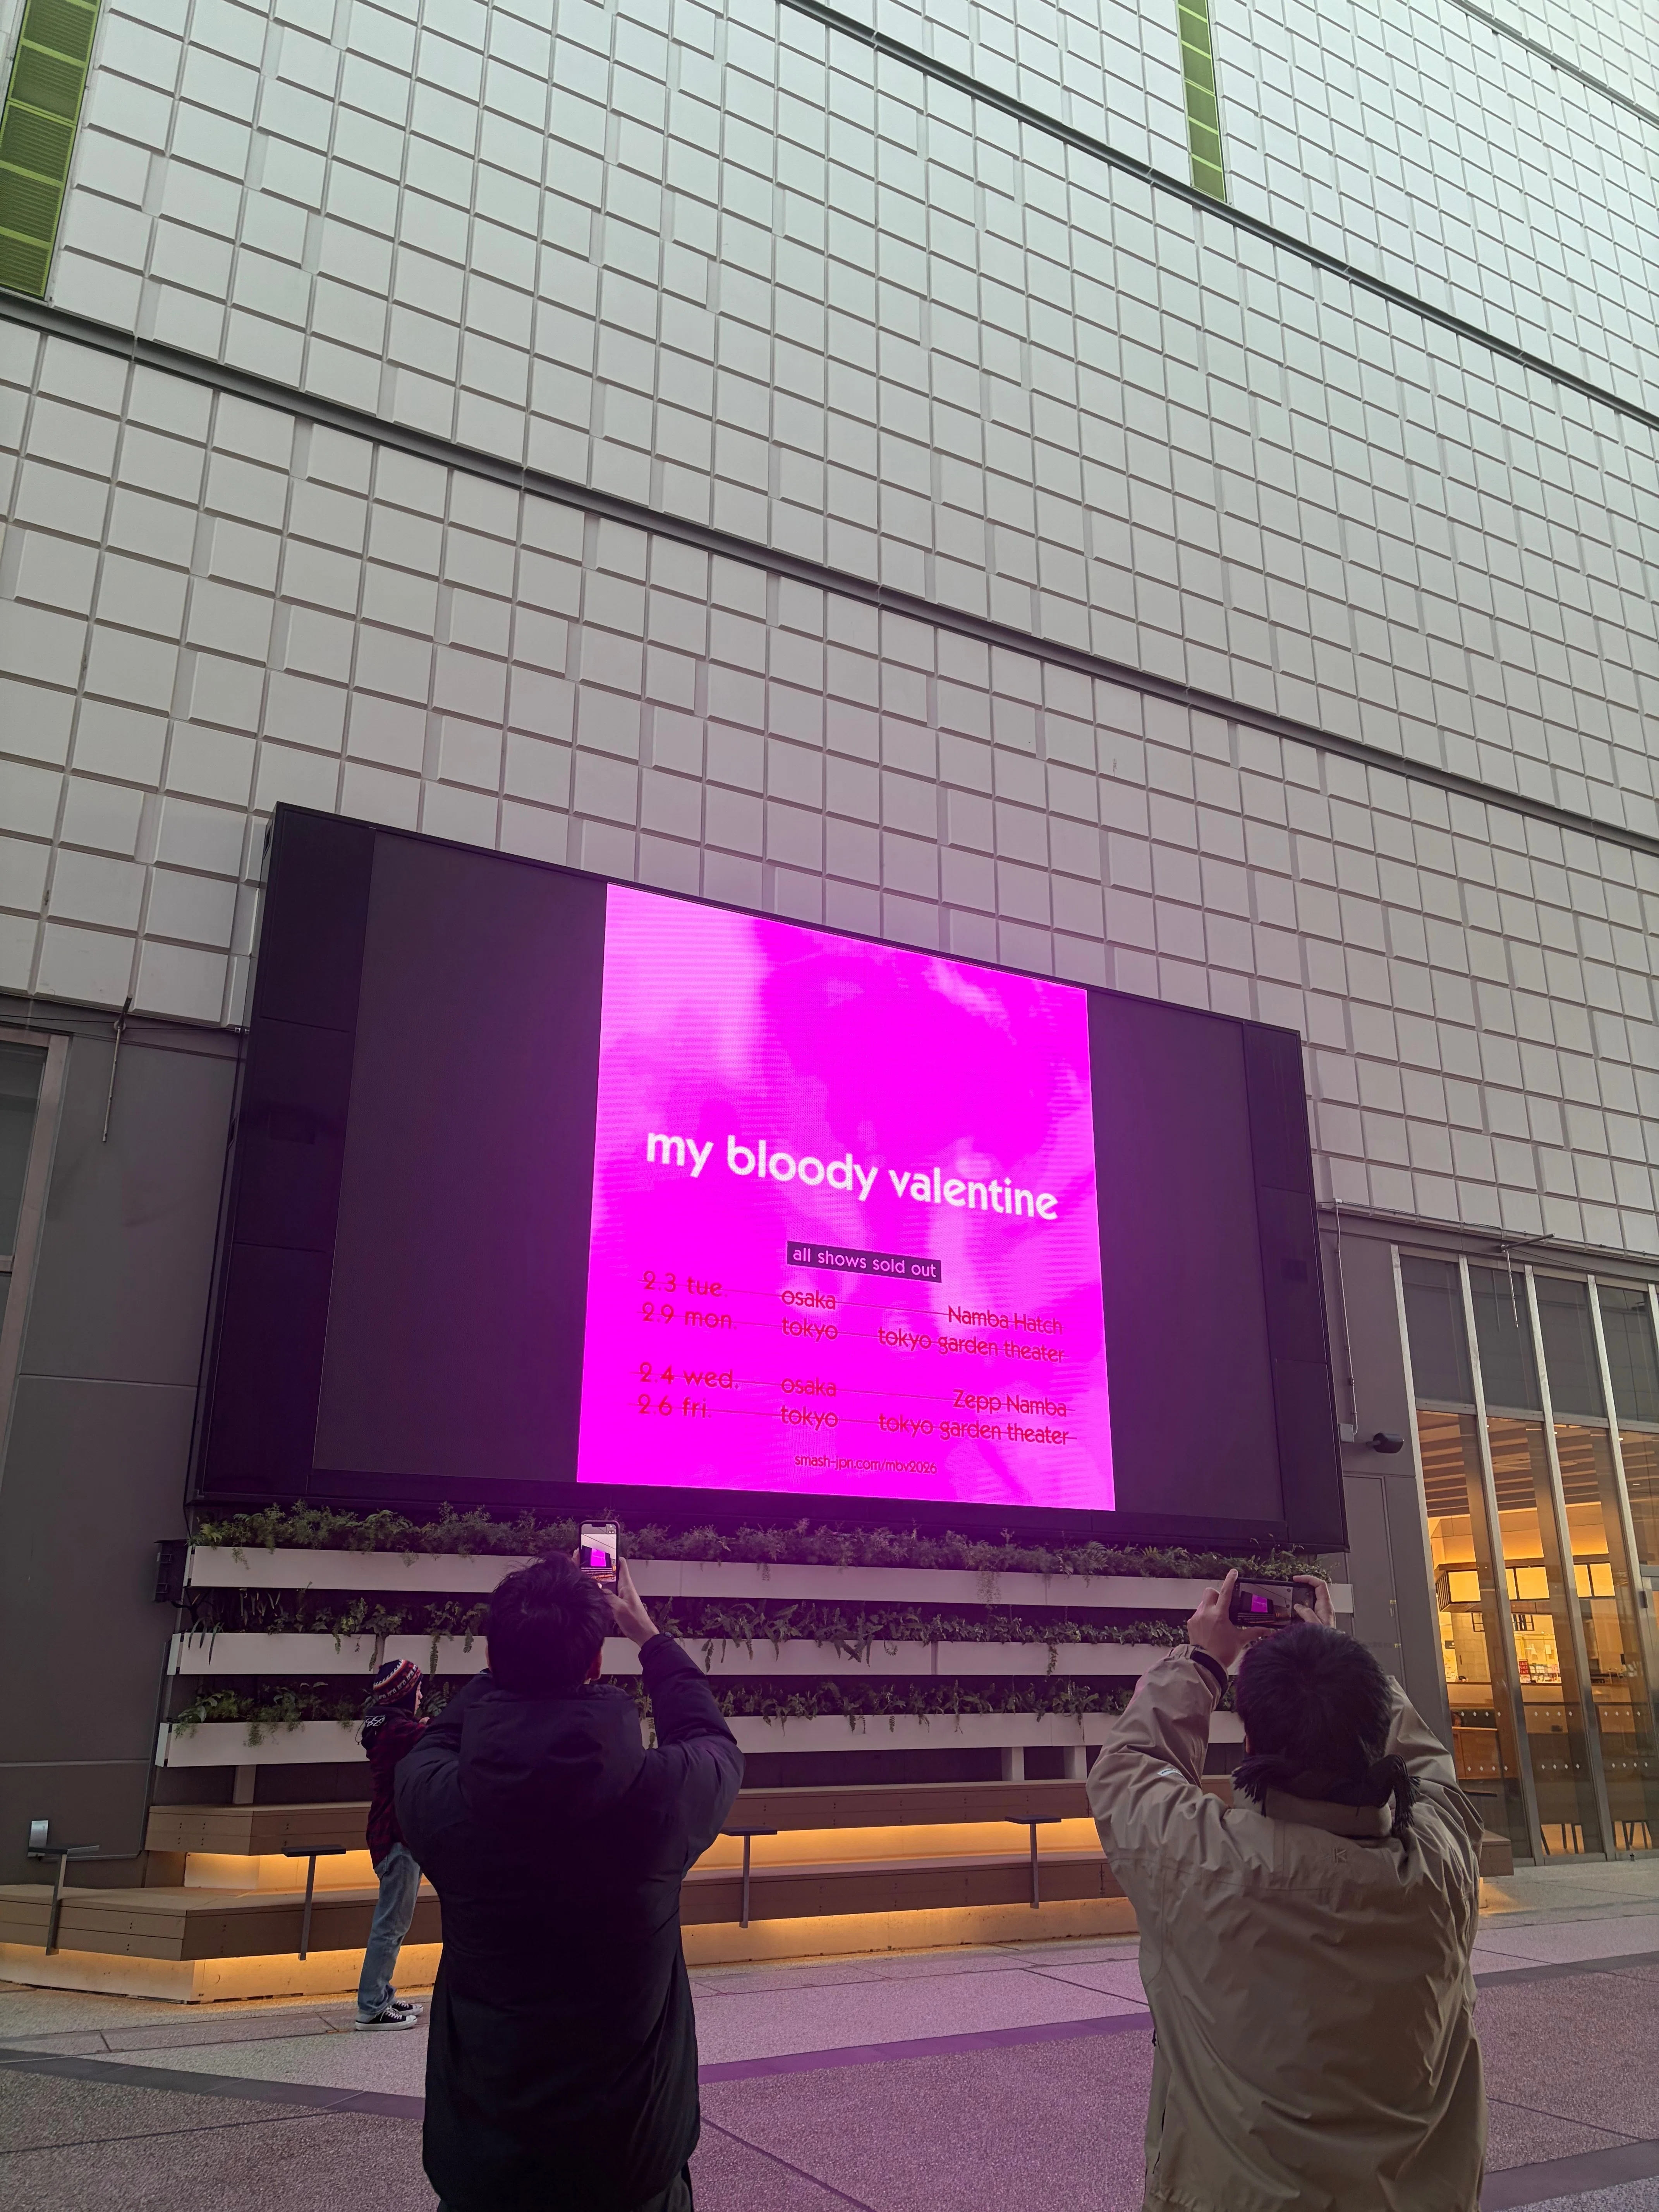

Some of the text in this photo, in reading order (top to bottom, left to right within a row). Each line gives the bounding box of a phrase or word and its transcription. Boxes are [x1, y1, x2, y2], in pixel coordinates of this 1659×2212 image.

[647, 1132, 1058, 1220] my bloody valentine
[793, 1248, 936, 1278] all shows sold out
[643, 1271, 676, 1293] 2.3
[781, 1290, 836, 1310] osaka
[948, 1305, 1009, 1329] Namba
[1014, 1313, 1063, 1335] Hatch
[642, 1302, 1065, 1363] 2.9 mon. tokyo tokyo garden theater
[639, 1362, 1067, 1417] 2.4 wed. osaka Zepp Namba
[639, 1393, 1068, 1445] 2.6 fri. tokyo tokyo garden theater
[795, 1455, 937, 1474] smash-jpn.com/mbv2026
